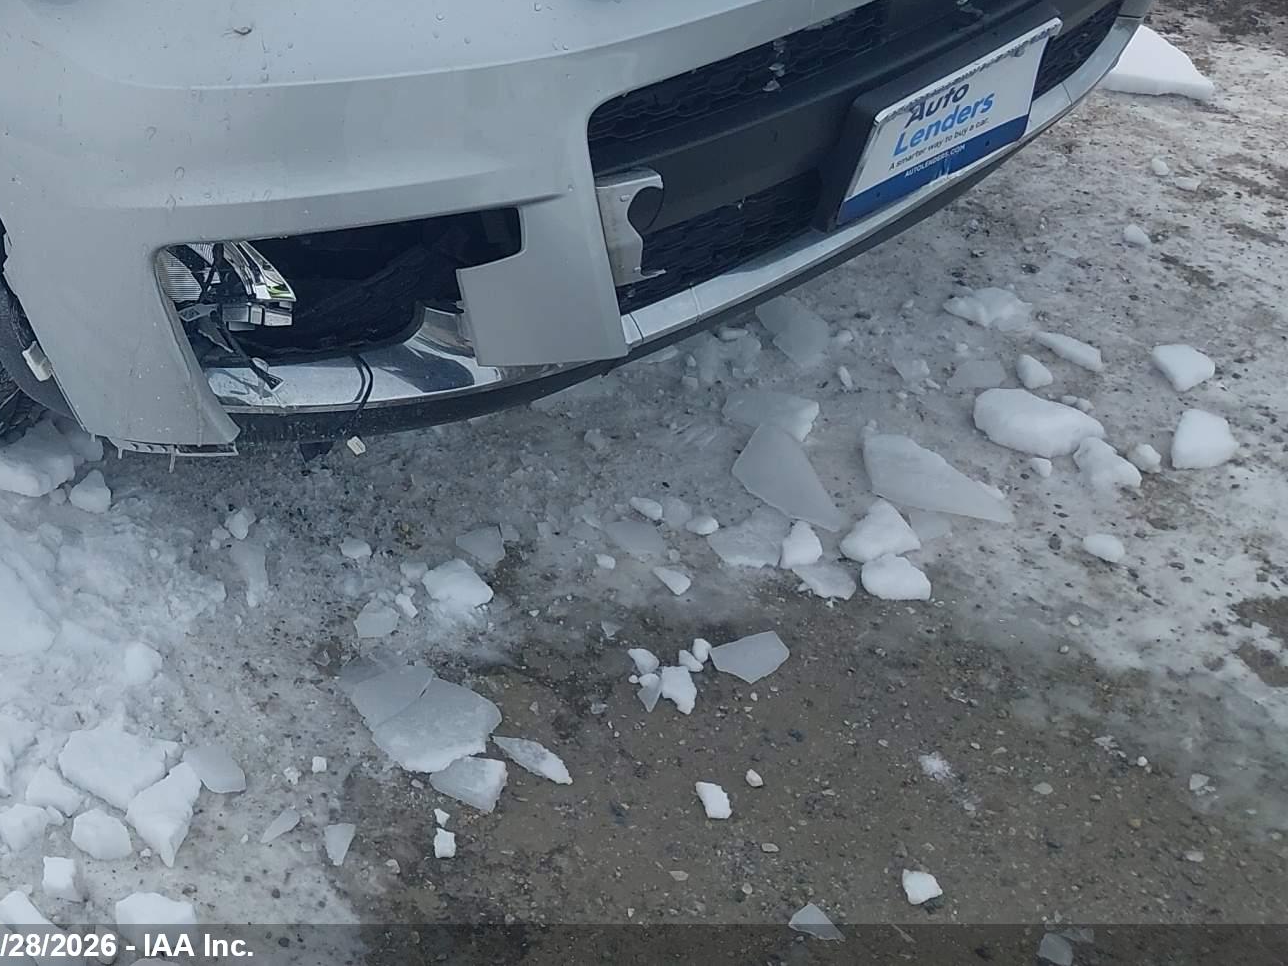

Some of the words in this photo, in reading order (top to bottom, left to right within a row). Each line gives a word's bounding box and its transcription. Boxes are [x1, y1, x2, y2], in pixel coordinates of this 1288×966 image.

[893, 92, 995, 156] Lenders
[904, 83, 970, 129] Auto
[889, 162, 895, 171] A
[896, 147, 926, 167] smarter
[928, 140, 943, 152] way
[945, 134, 953, 143] to
[954, 128, 967, 139] buy
[904, 143, 966, 178] AUTOLENDERS.COM
